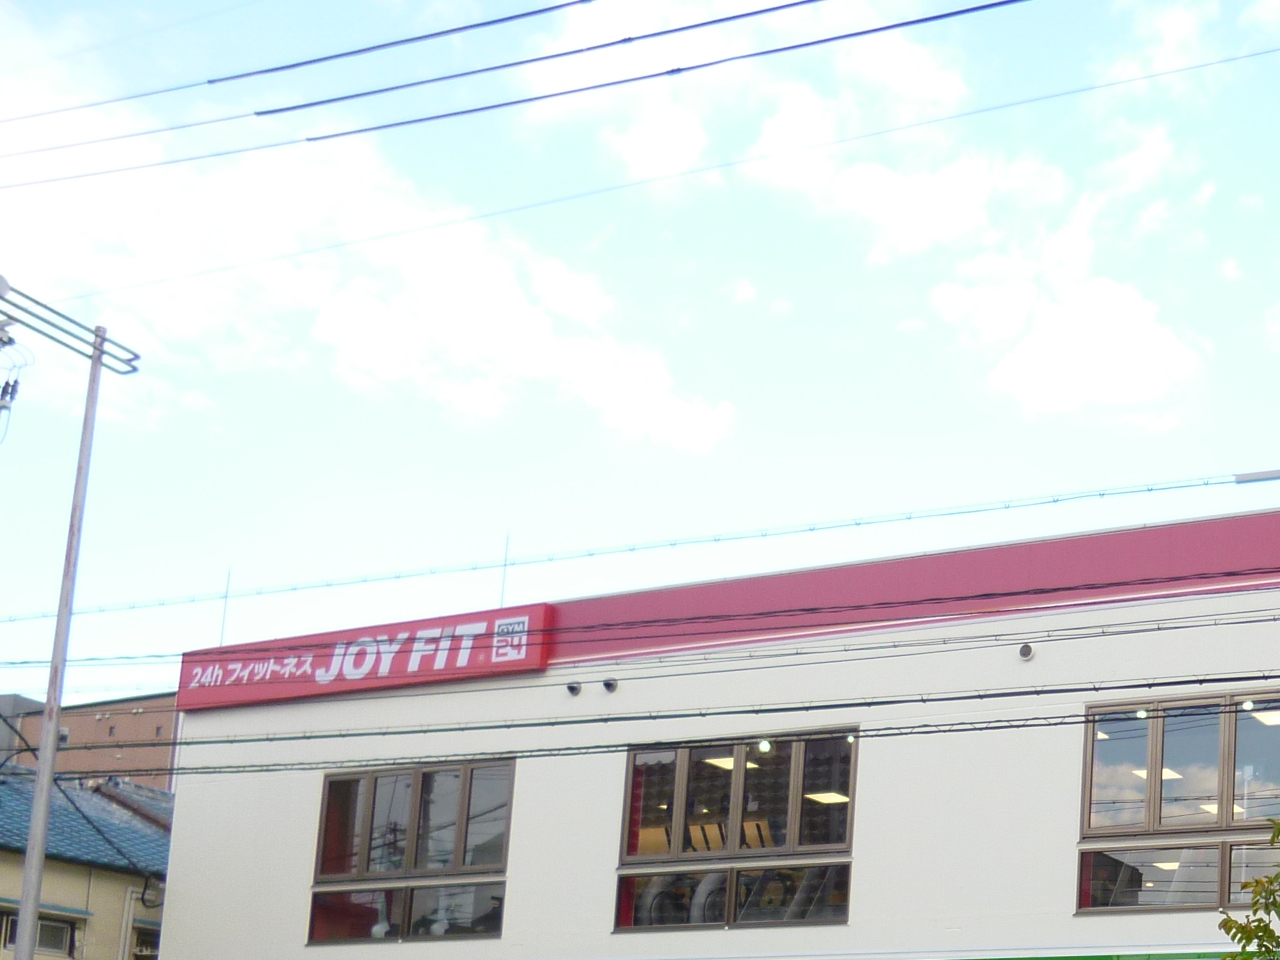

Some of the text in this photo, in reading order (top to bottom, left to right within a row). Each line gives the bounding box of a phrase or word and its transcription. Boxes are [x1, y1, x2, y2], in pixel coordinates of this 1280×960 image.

[188, 653, 313, 689] 24h フィットネス
[315, 622, 487, 685] JOY FIT
